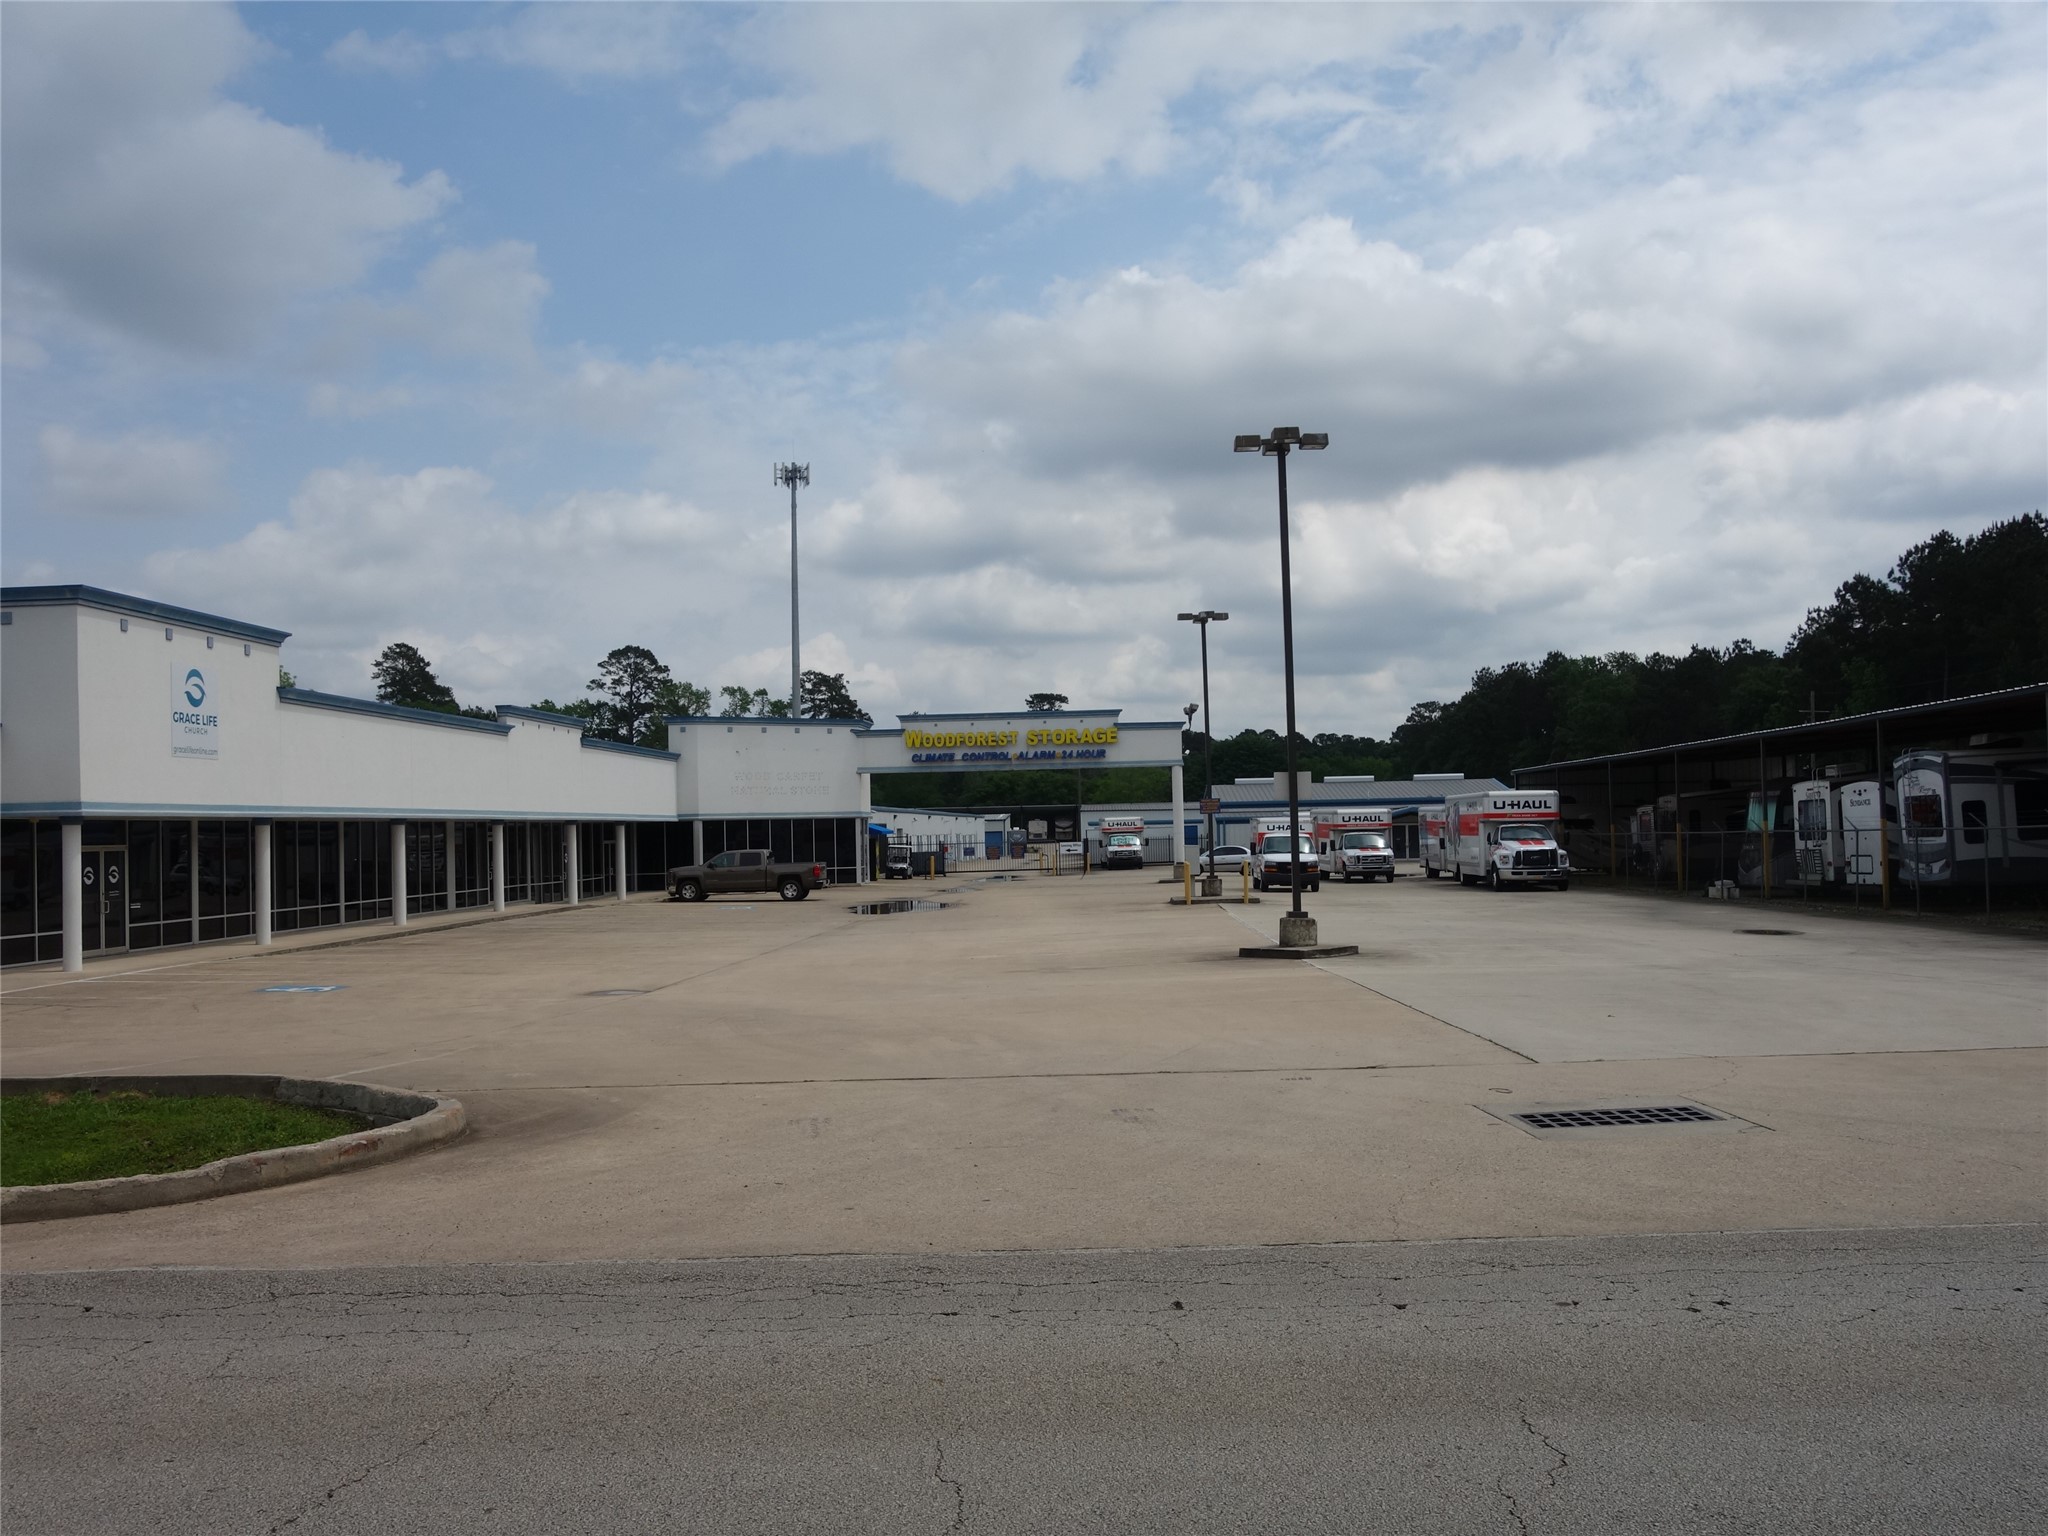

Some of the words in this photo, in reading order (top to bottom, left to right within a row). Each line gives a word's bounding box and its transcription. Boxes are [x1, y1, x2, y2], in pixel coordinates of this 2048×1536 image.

[172, 711, 201, 726] GRACE
[202, 714, 218, 727] LIFE
[184, 726, 208, 735] CHURCH
[904, 730, 1018, 748] WOODFOREST
[1026, 727, 1119, 746] STORAGE
[911, 752, 956, 763] CLIMATE
[961, 751, 1012, 762] CONTROL
[1017, 750, 1056, 760] ALARM
[1061, 749, 1074, 760] 24
[1075, 748, 1107, 759] HOUR
[1493, 799, 1552, 810] U-HAUL
[1849, 798, 1871, 807] SUNDANCE
[1342, 815, 1384, 823] U-HAUL
